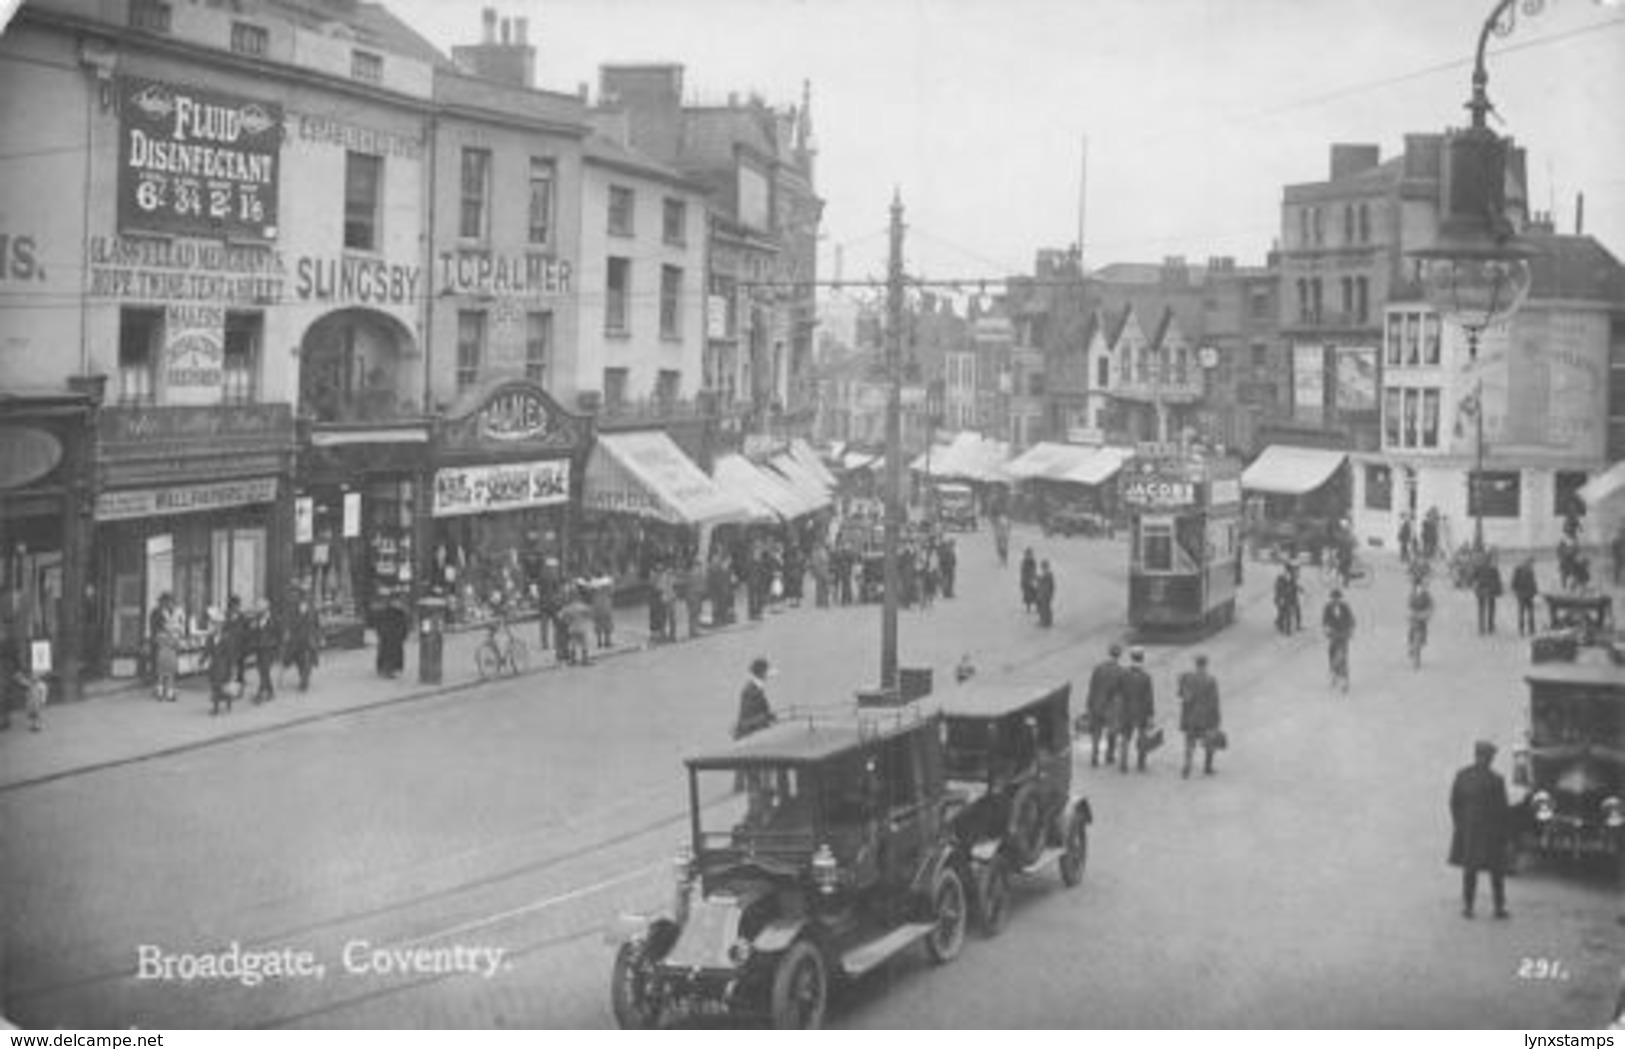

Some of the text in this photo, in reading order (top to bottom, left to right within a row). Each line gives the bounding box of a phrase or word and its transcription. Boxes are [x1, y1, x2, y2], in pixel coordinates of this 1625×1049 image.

[172, 96, 242, 142] FLUID
[129, 129, 272, 183] DISINFECTANT
[295, 255, 421, 302] SLINGSBY
